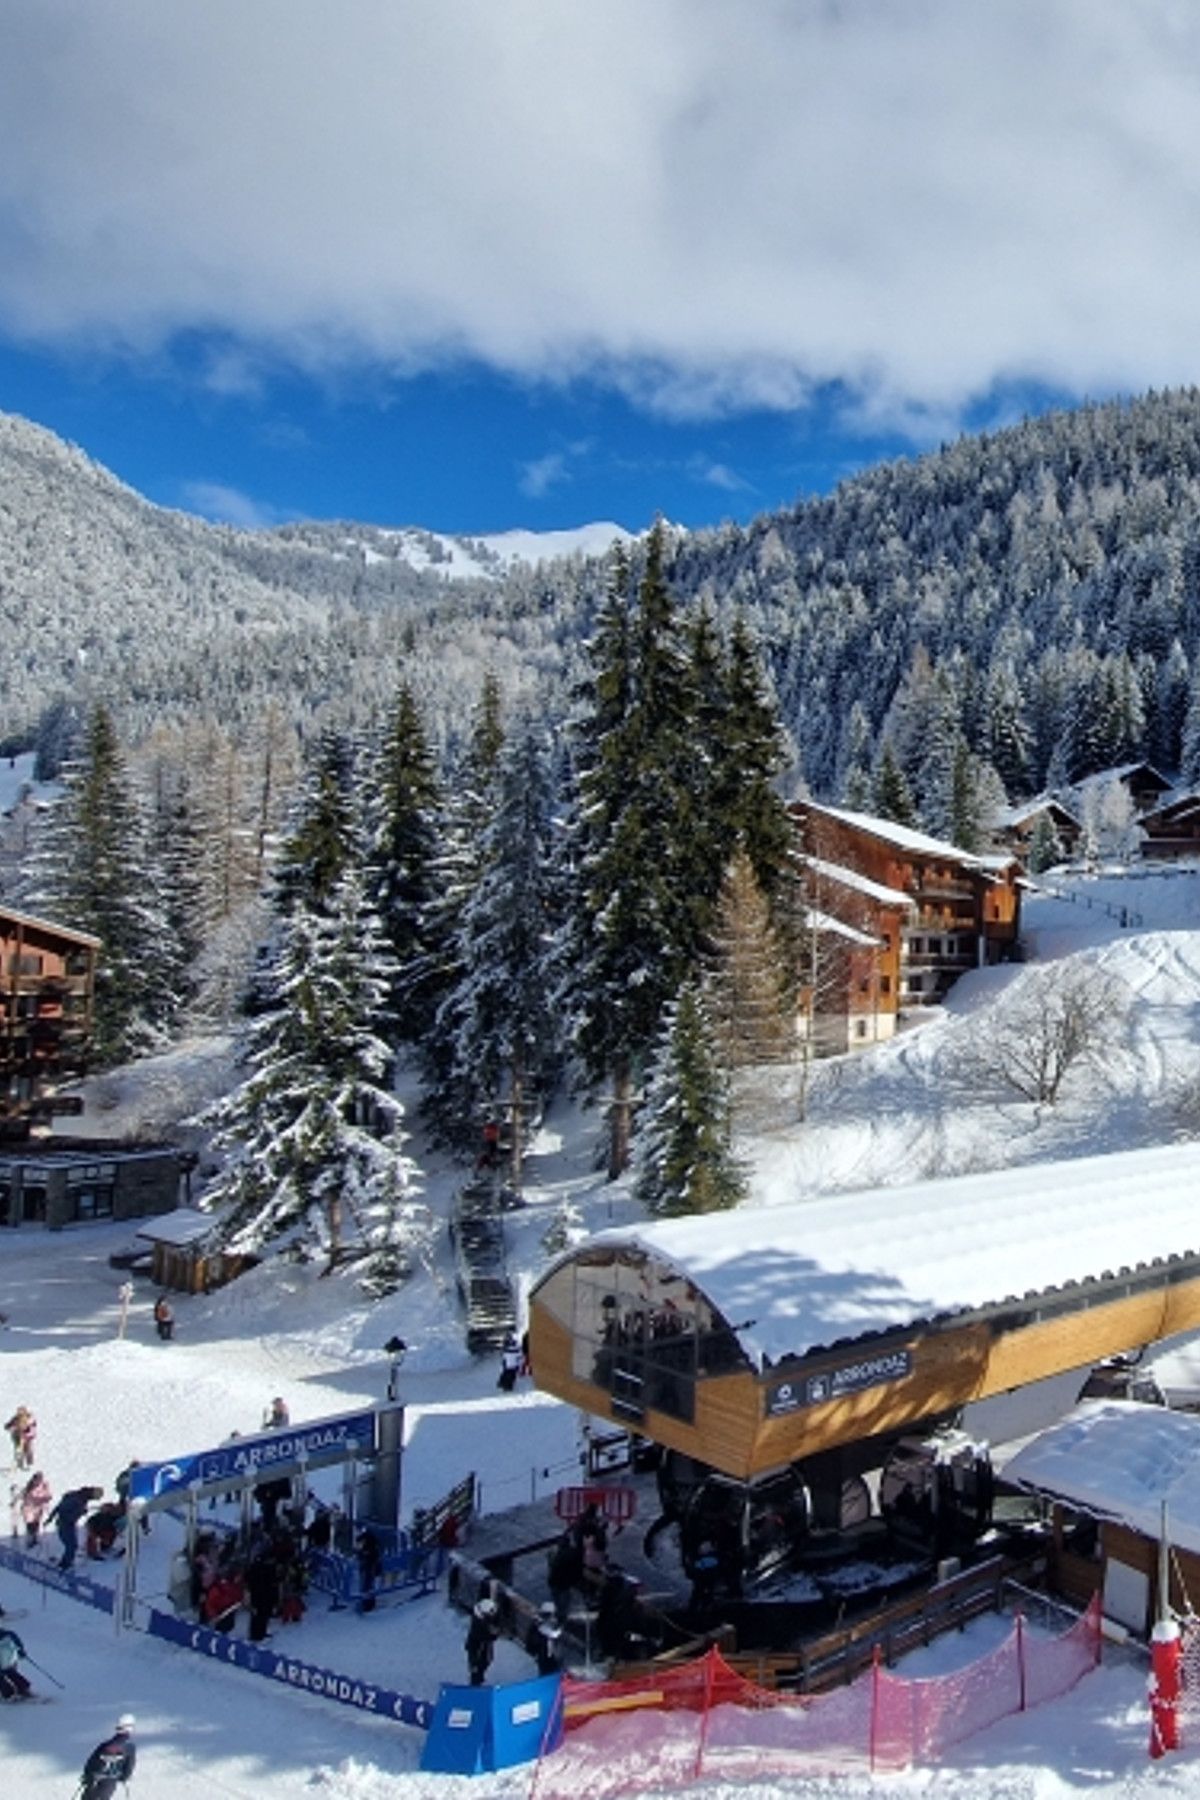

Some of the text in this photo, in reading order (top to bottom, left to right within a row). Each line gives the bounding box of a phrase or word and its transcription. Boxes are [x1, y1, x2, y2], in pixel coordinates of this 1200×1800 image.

[832, 1352, 907, 1384] ARRONDAZ
[233, 1426, 348, 1469] ARRONDAZ
[273, 1660, 376, 1708] ARRONDAZ
